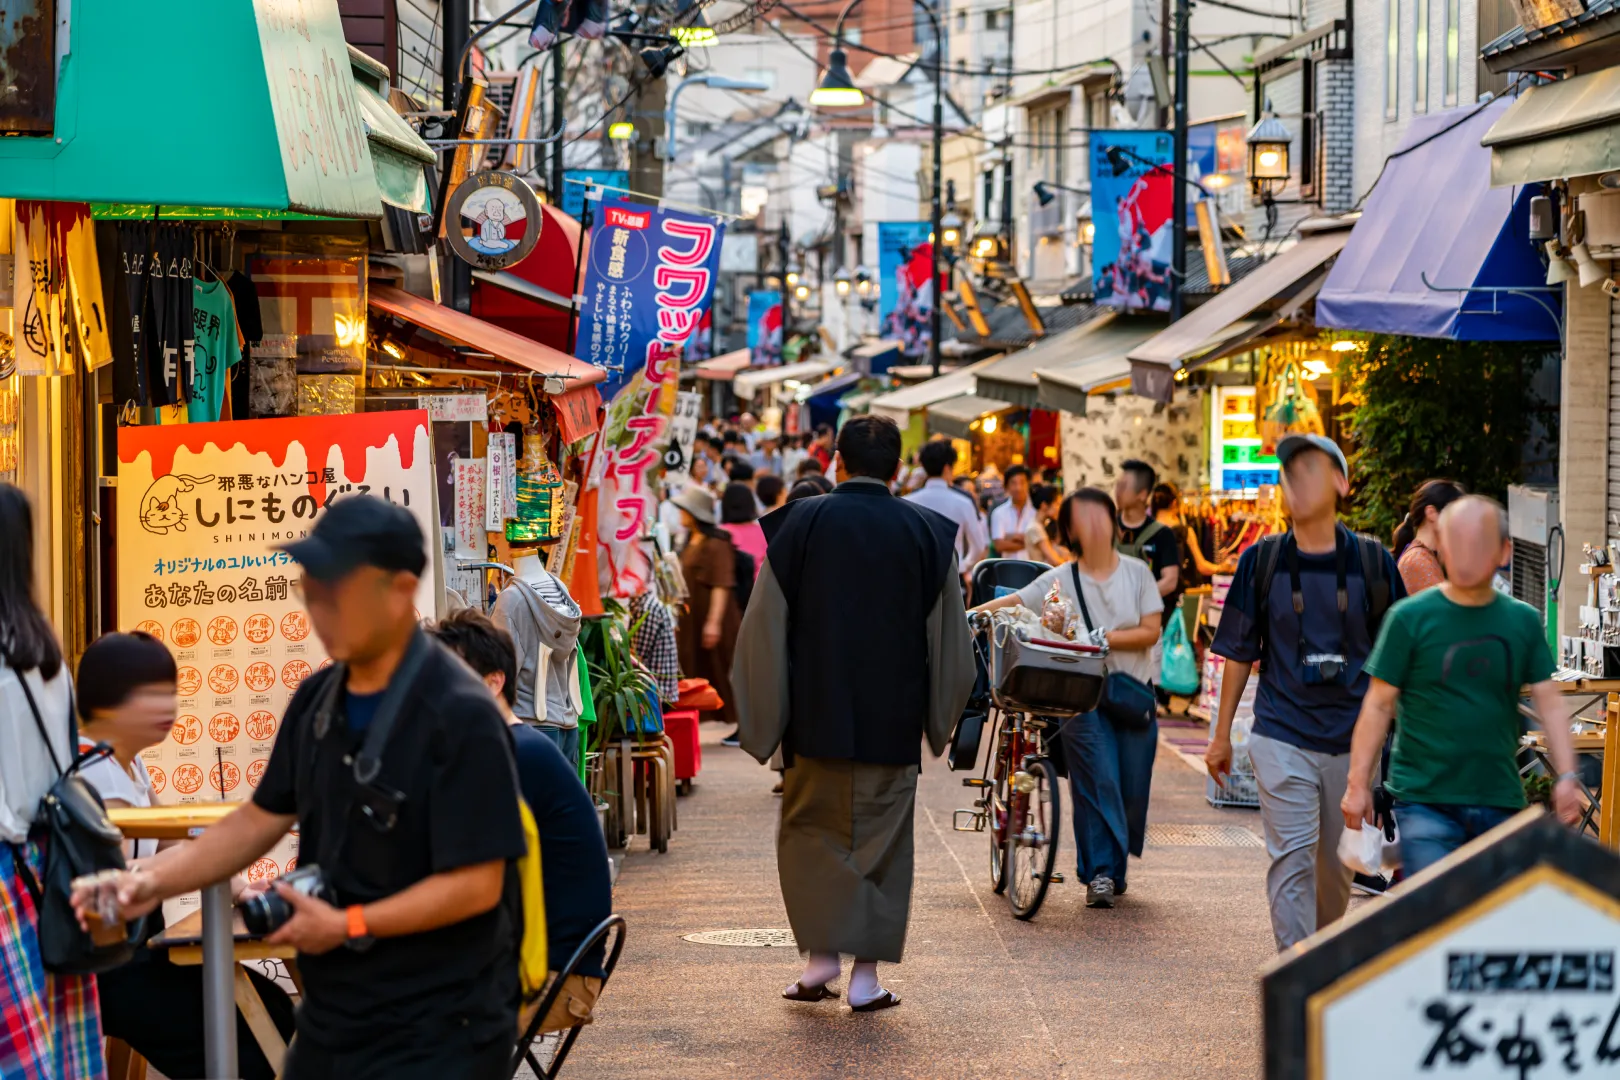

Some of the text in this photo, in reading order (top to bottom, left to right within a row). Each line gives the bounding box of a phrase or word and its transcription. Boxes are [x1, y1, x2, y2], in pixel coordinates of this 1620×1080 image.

[607, 228, 630, 279] 新食感
[619, 286, 633, 384] ふわふわクリーー
[217, 468, 338, 492] 邪悪なハンコ屋
[145, 575, 302, 608] あなたの名前
[216, 618, 235, 632] 伊藤
[248, 618, 270, 628] 伊藤
[215, 668, 235, 680] 伊藤
[249, 664, 270, 675] 伊藤
[185, 718, 197, 740] 伊藤
[212, 716, 233, 728] 伊藤
[177, 766, 198, 778] 伊藤
